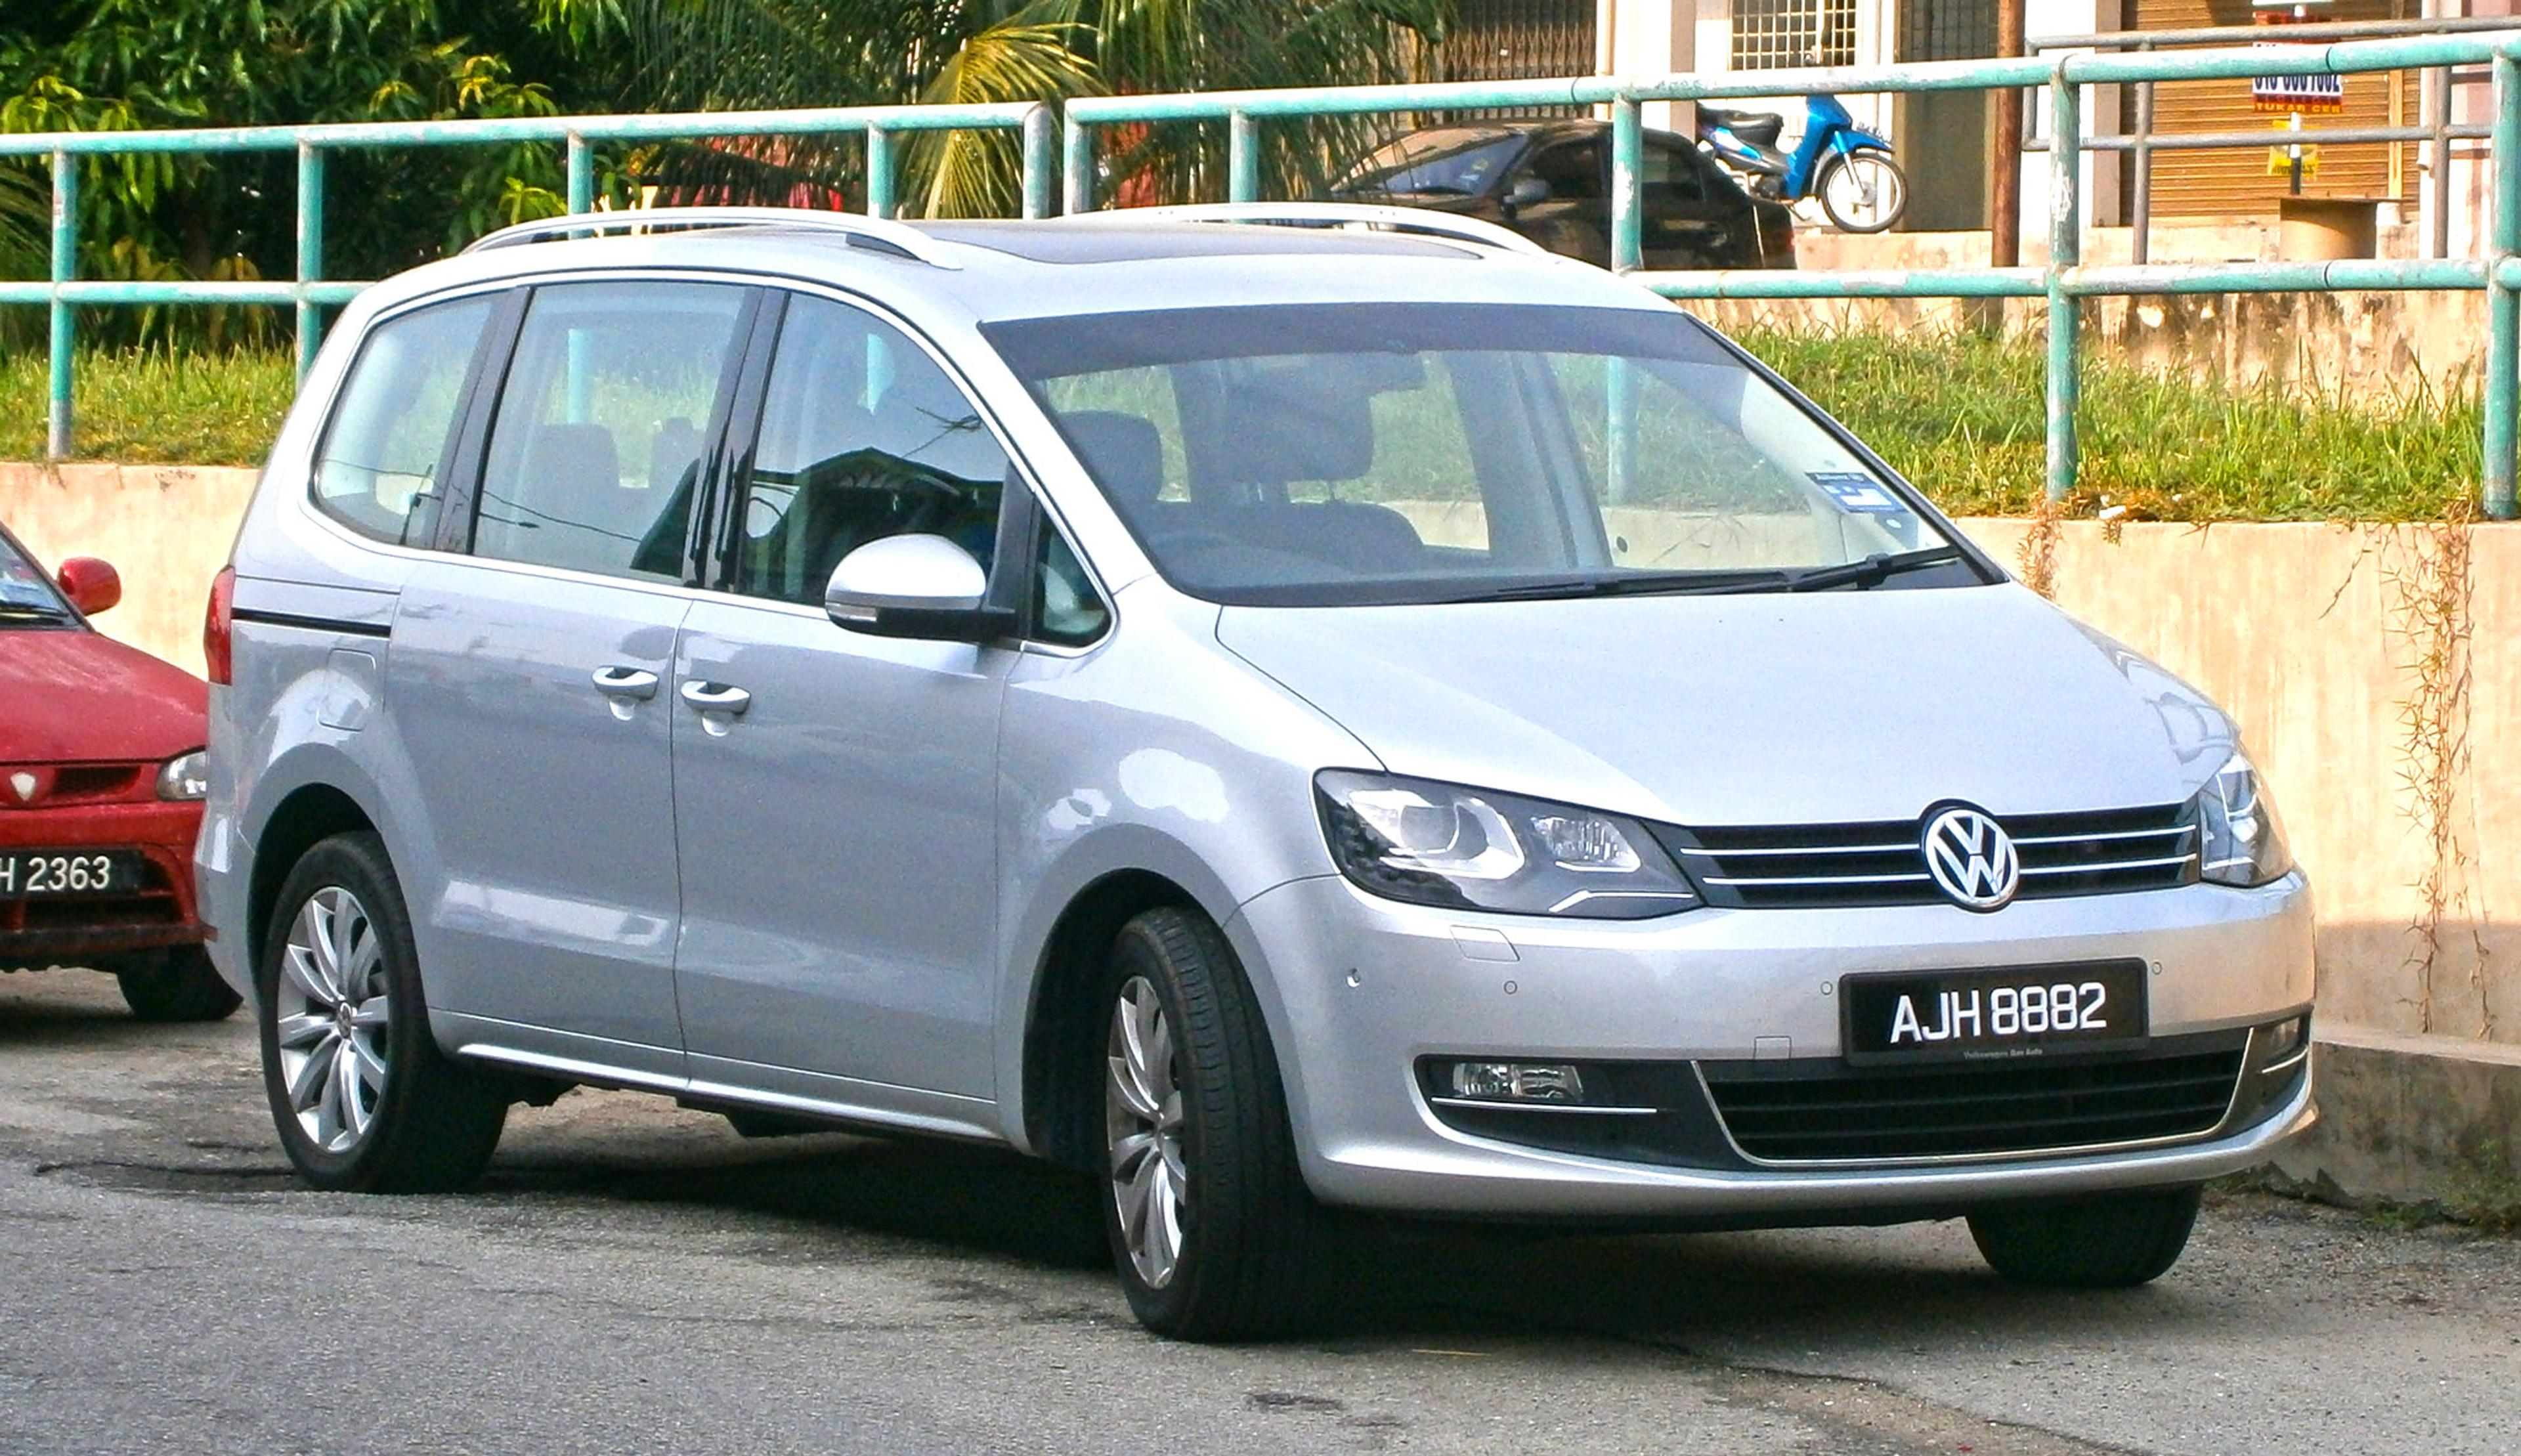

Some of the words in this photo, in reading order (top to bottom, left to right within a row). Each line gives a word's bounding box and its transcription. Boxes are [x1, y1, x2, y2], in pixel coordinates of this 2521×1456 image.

[0, 856, 15, 891] H
[26, 855, 111, 891] 2363
[1933, 814, 2014, 901] VW
[1890, 989, 1981, 1044] AJH
[1989, 982, 2107, 1035] 8882
